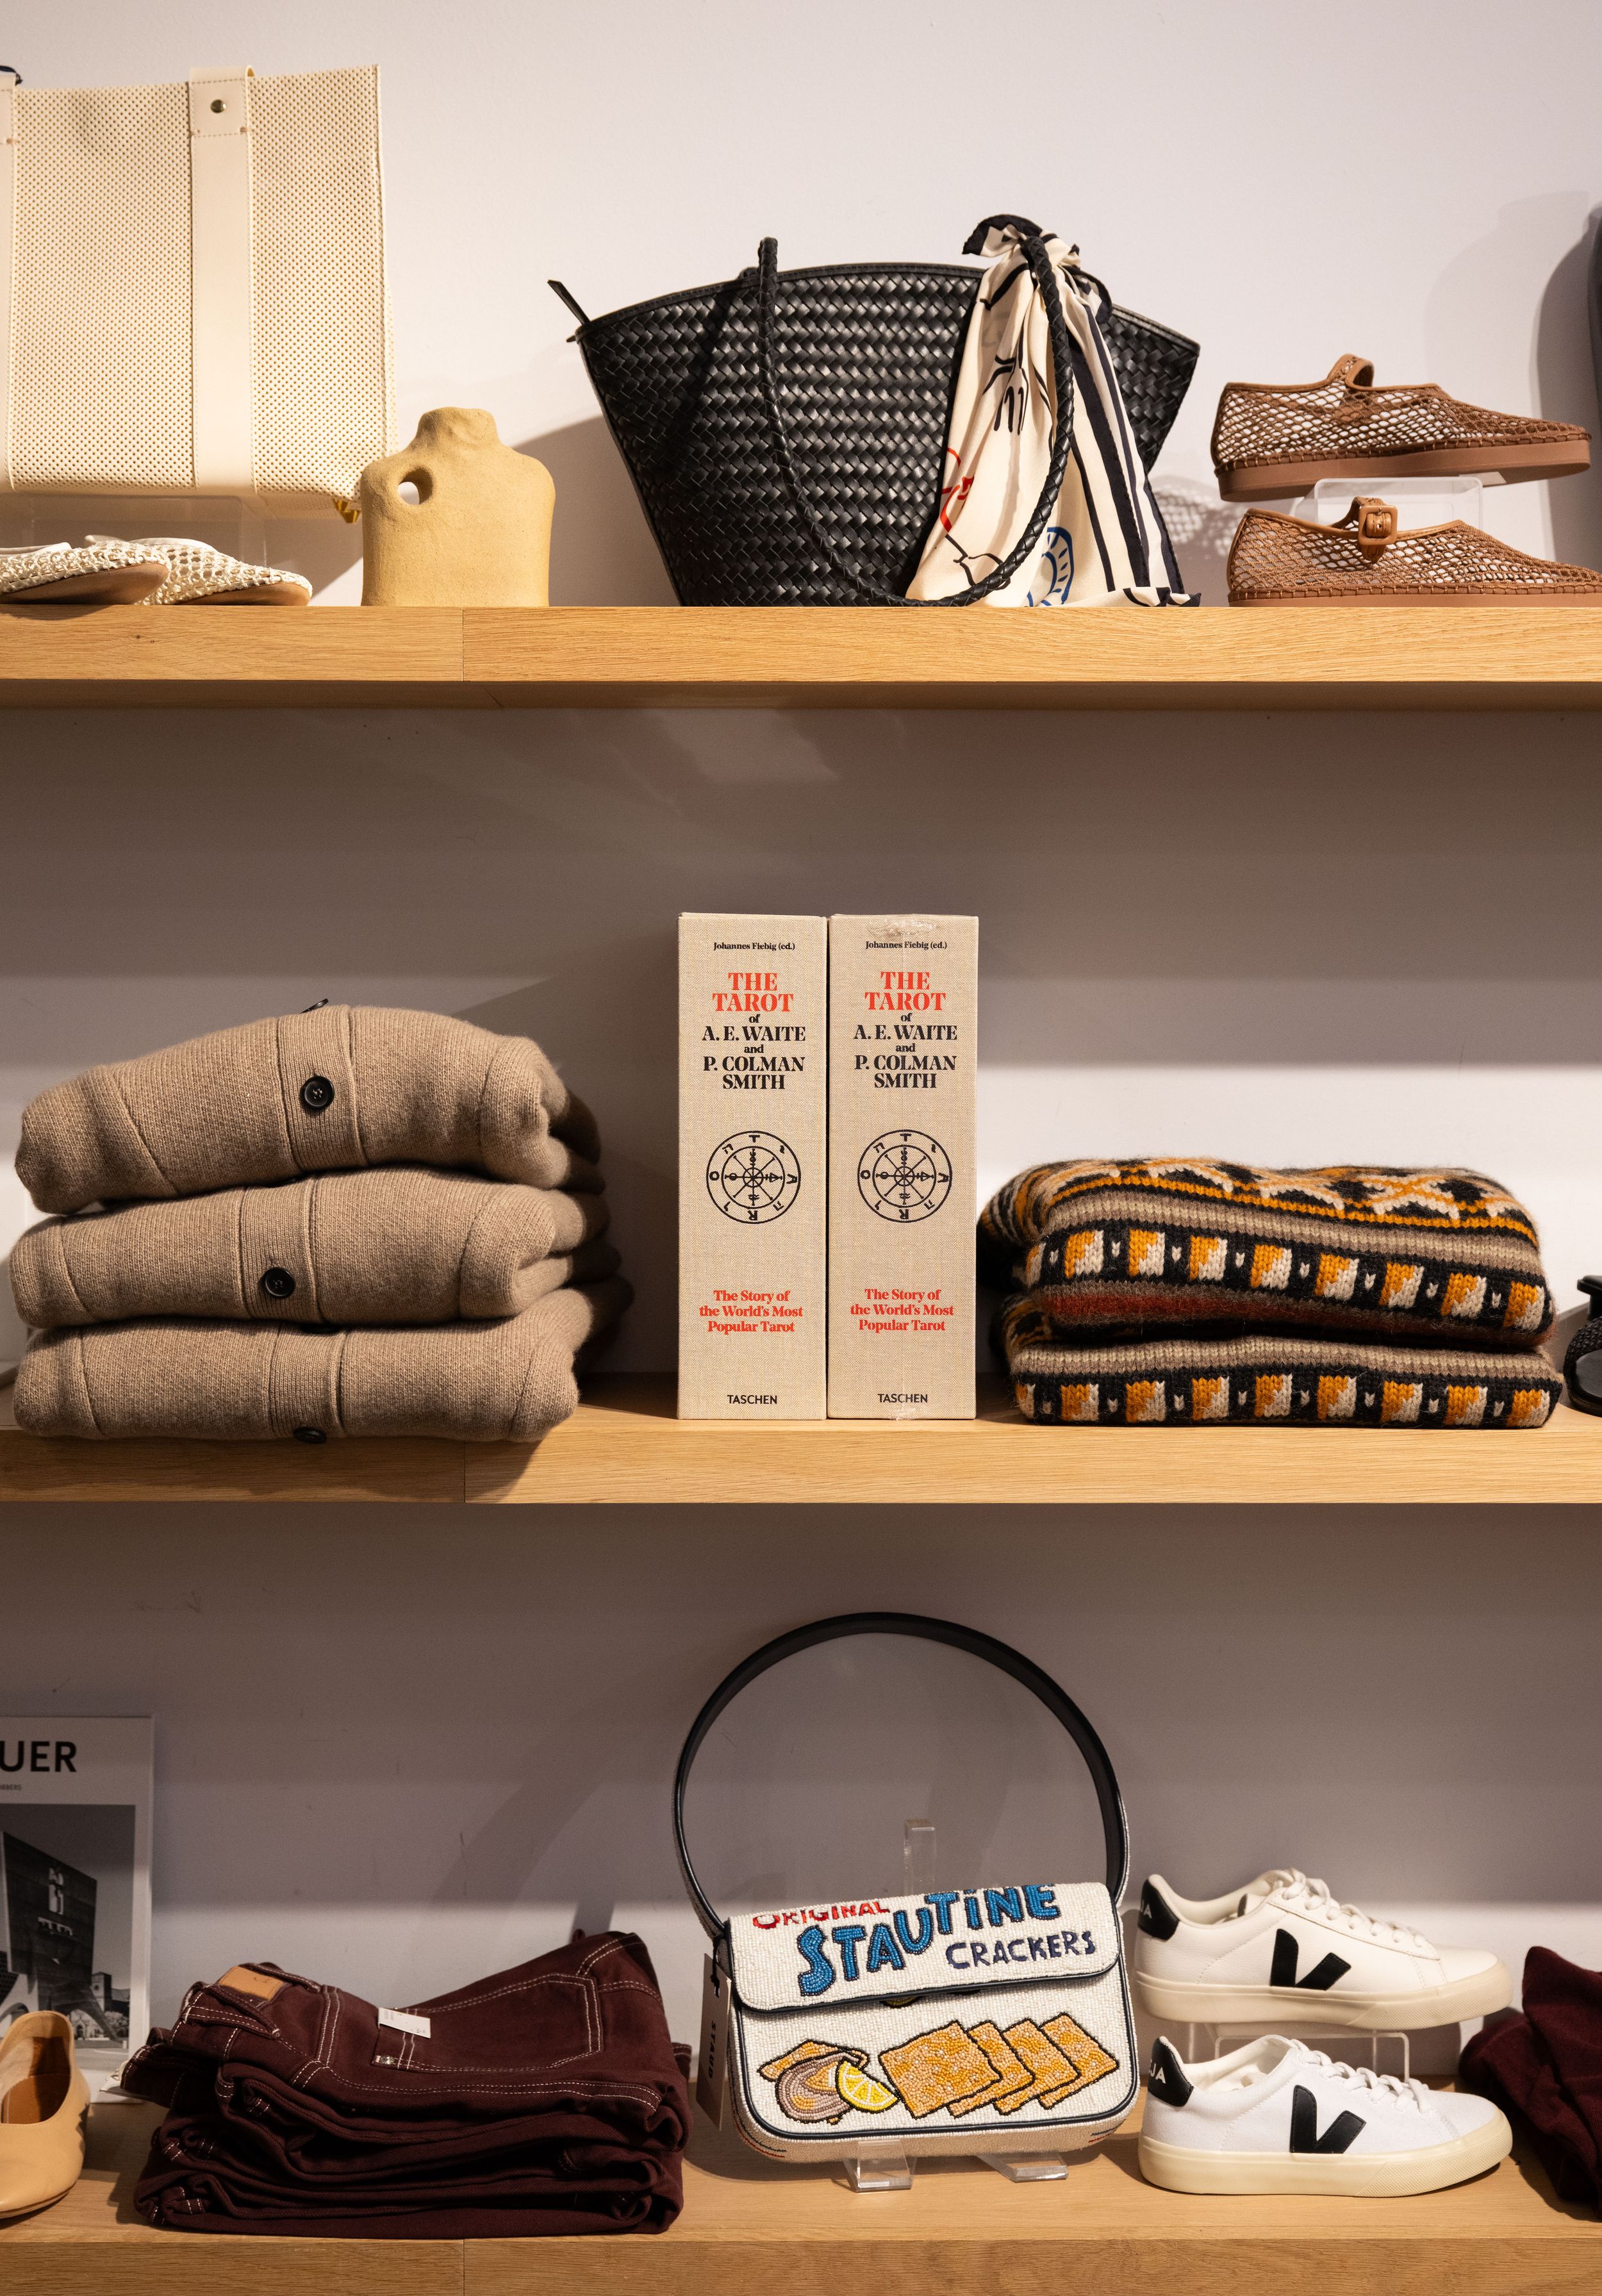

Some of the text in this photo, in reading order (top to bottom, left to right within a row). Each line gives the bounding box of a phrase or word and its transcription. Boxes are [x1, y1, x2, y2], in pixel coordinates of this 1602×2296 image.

[713, 942, 795, 952] Johannes Fiebig (ed.)
[865, 941, 947, 951] Johannes Fiebig (ed.)
[727, 973, 777, 990] THE
[880, 971, 930, 989] THE
[711, 993, 793, 1011] TAROT
[864, 992, 946, 1010] TAROT
[748, 1013, 761, 1023] of
[900, 1012, 912, 1022] of
[702, 1025, 805, 1042] A. E. WAITE
[854, 1024, 957, 1041] A. E. WAITE
[743, 1044, 764, 1054] and
[895, 1043, 916, 1052] and
[703, 1056, 805, 1072] P. COLMAN
[854, 1055, 957, 1071] P. COLMAN
[722, 1074, 785, 1089] SMITH
[874, 1073, 937, 1089] SMITH
[713, 1290, 789, 1303] The Story of
[864, 1289, 941, 1302] The Story of
[698, 1305, 802, 1316] the World's Most
[850, 1304, 954, 1315] the World's Most
[707, 1321, 794, 1334] Popular Tarot
[859, 1319, 945, 1332] Popular Tarot
[727, 1394, 777, 1405] TASCHEN
[877, 1393, 928, 1403] TASCHEN
[752, 1901, 890, 1929] ORIGINAL
[946, 1931, 1096, 1969] CRACKERS
[708, 2020, 716, 2079] STAUD
[1149, 2059, 1166, 2084] JA
